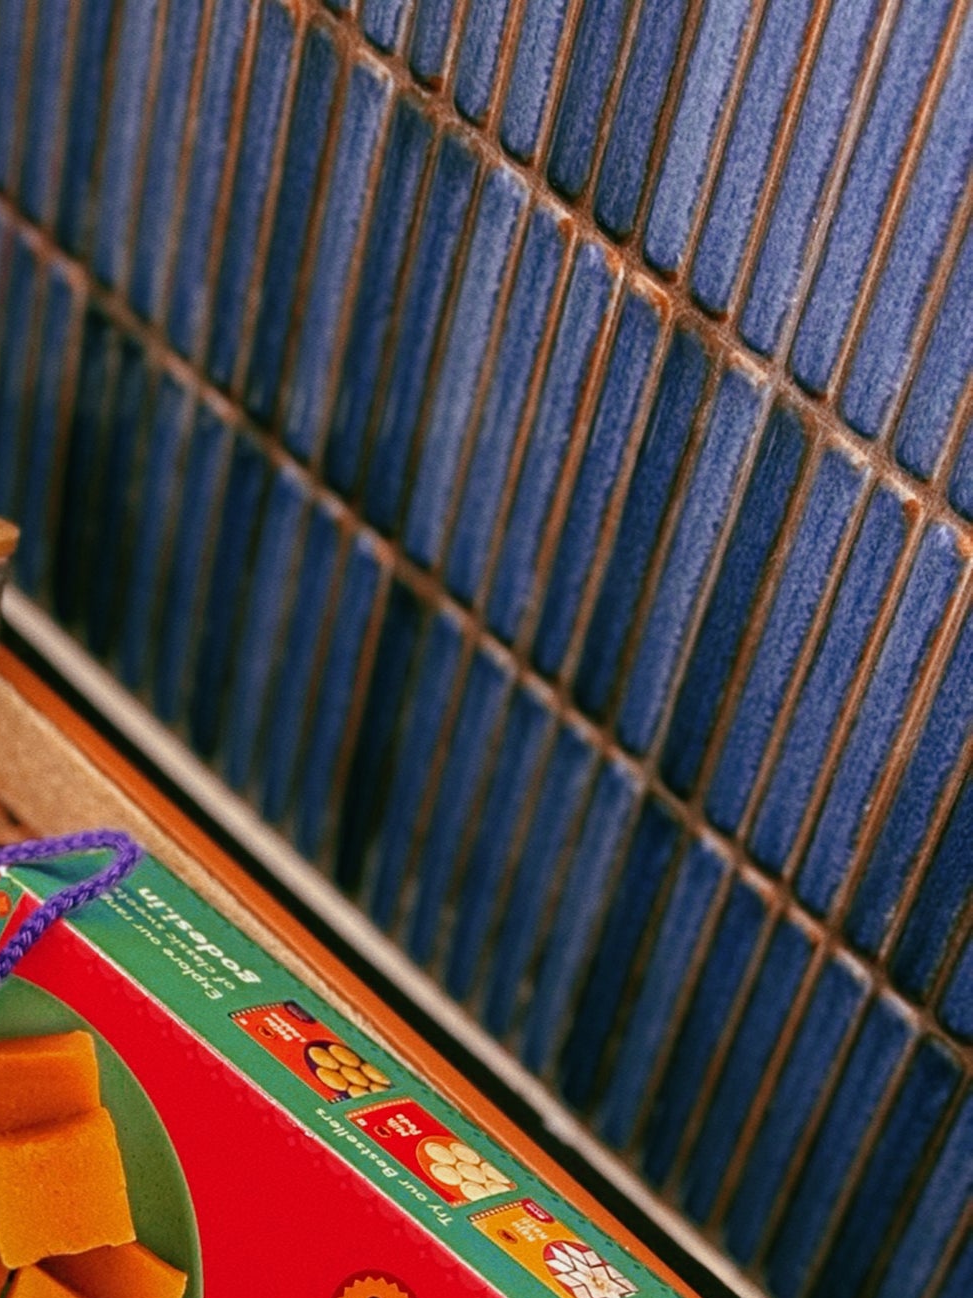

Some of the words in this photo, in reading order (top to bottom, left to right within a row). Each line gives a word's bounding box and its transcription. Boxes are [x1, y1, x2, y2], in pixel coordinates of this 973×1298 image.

[99, 893, 134, 921] rang
[132, 922, 162, 946] our
[165, 932, 216, 974] classic
[162, 948, 223, 1000] Explore
[212, 976, 236, 991] of
[315, 1107, 399, 1178] Bestsellers
[398, 1179, 428, 1202] our
[427, 1204, 454, 1227] Try
